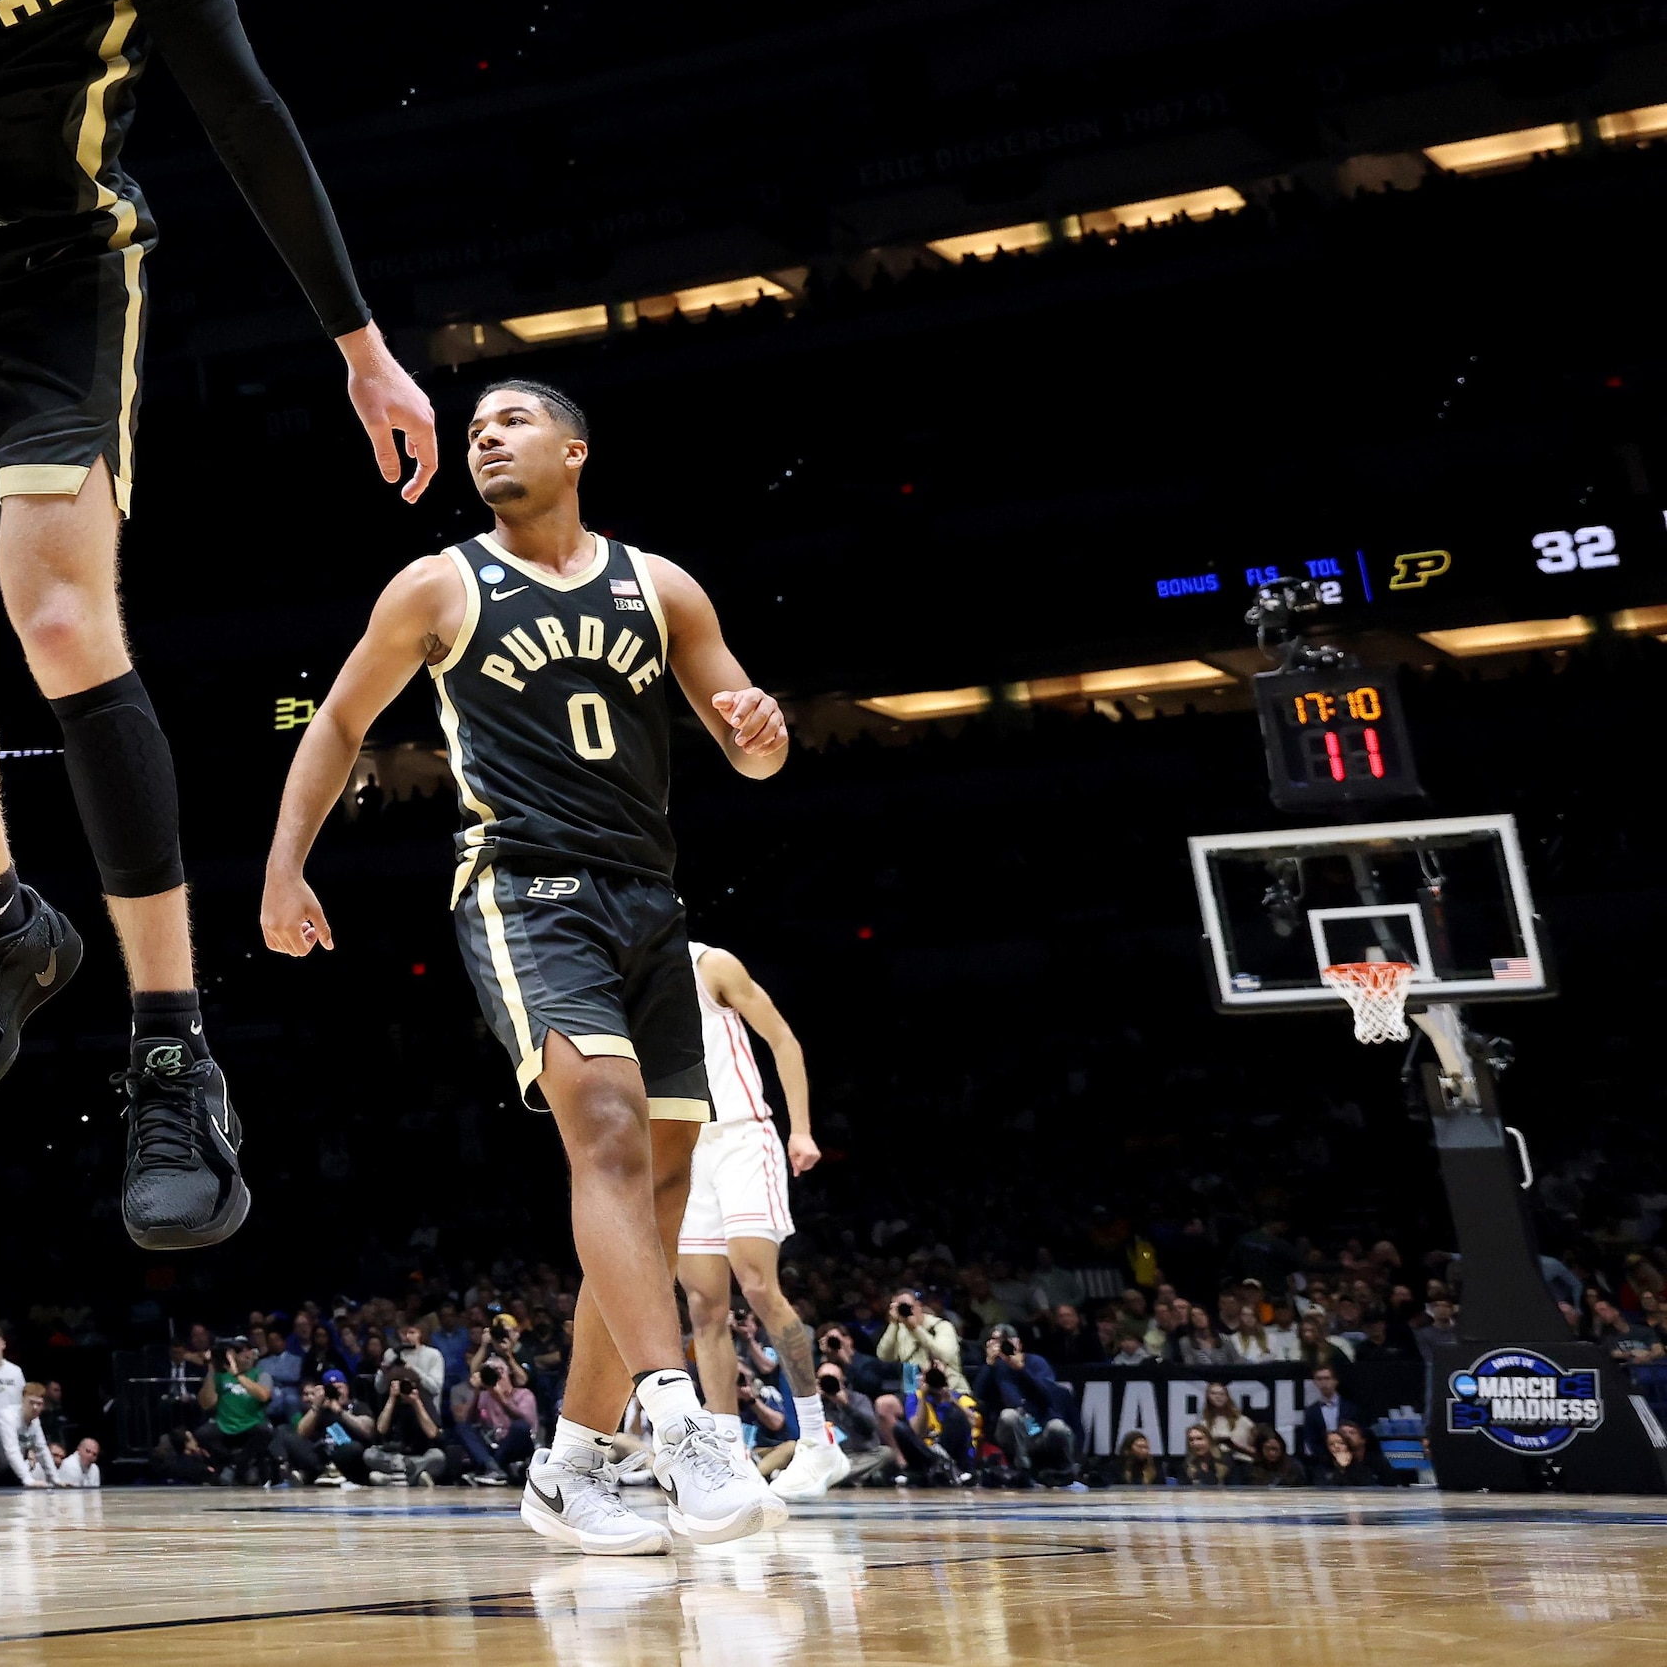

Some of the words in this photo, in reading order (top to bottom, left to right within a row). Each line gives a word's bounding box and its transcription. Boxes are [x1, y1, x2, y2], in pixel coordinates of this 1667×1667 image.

[1531, 524, 1621, 574] 32
[1245, 566, 1279, 586] FLS
[1305, 558, 1343, 578] TOL
[1157, 574, 1220, 599] BONUS
[1319, 580, 1343, 605] 2
[479, 614, 663, 695] PURDUE
[1294, 687, 1382, 724] 17:10
[566, 692, 618, 761] 0
[1324, 727, 1385, 783] 11
[1478, 1377, 1557, 1397] MARCH
[1492, 1399, 1598, 1420] MADNESS
